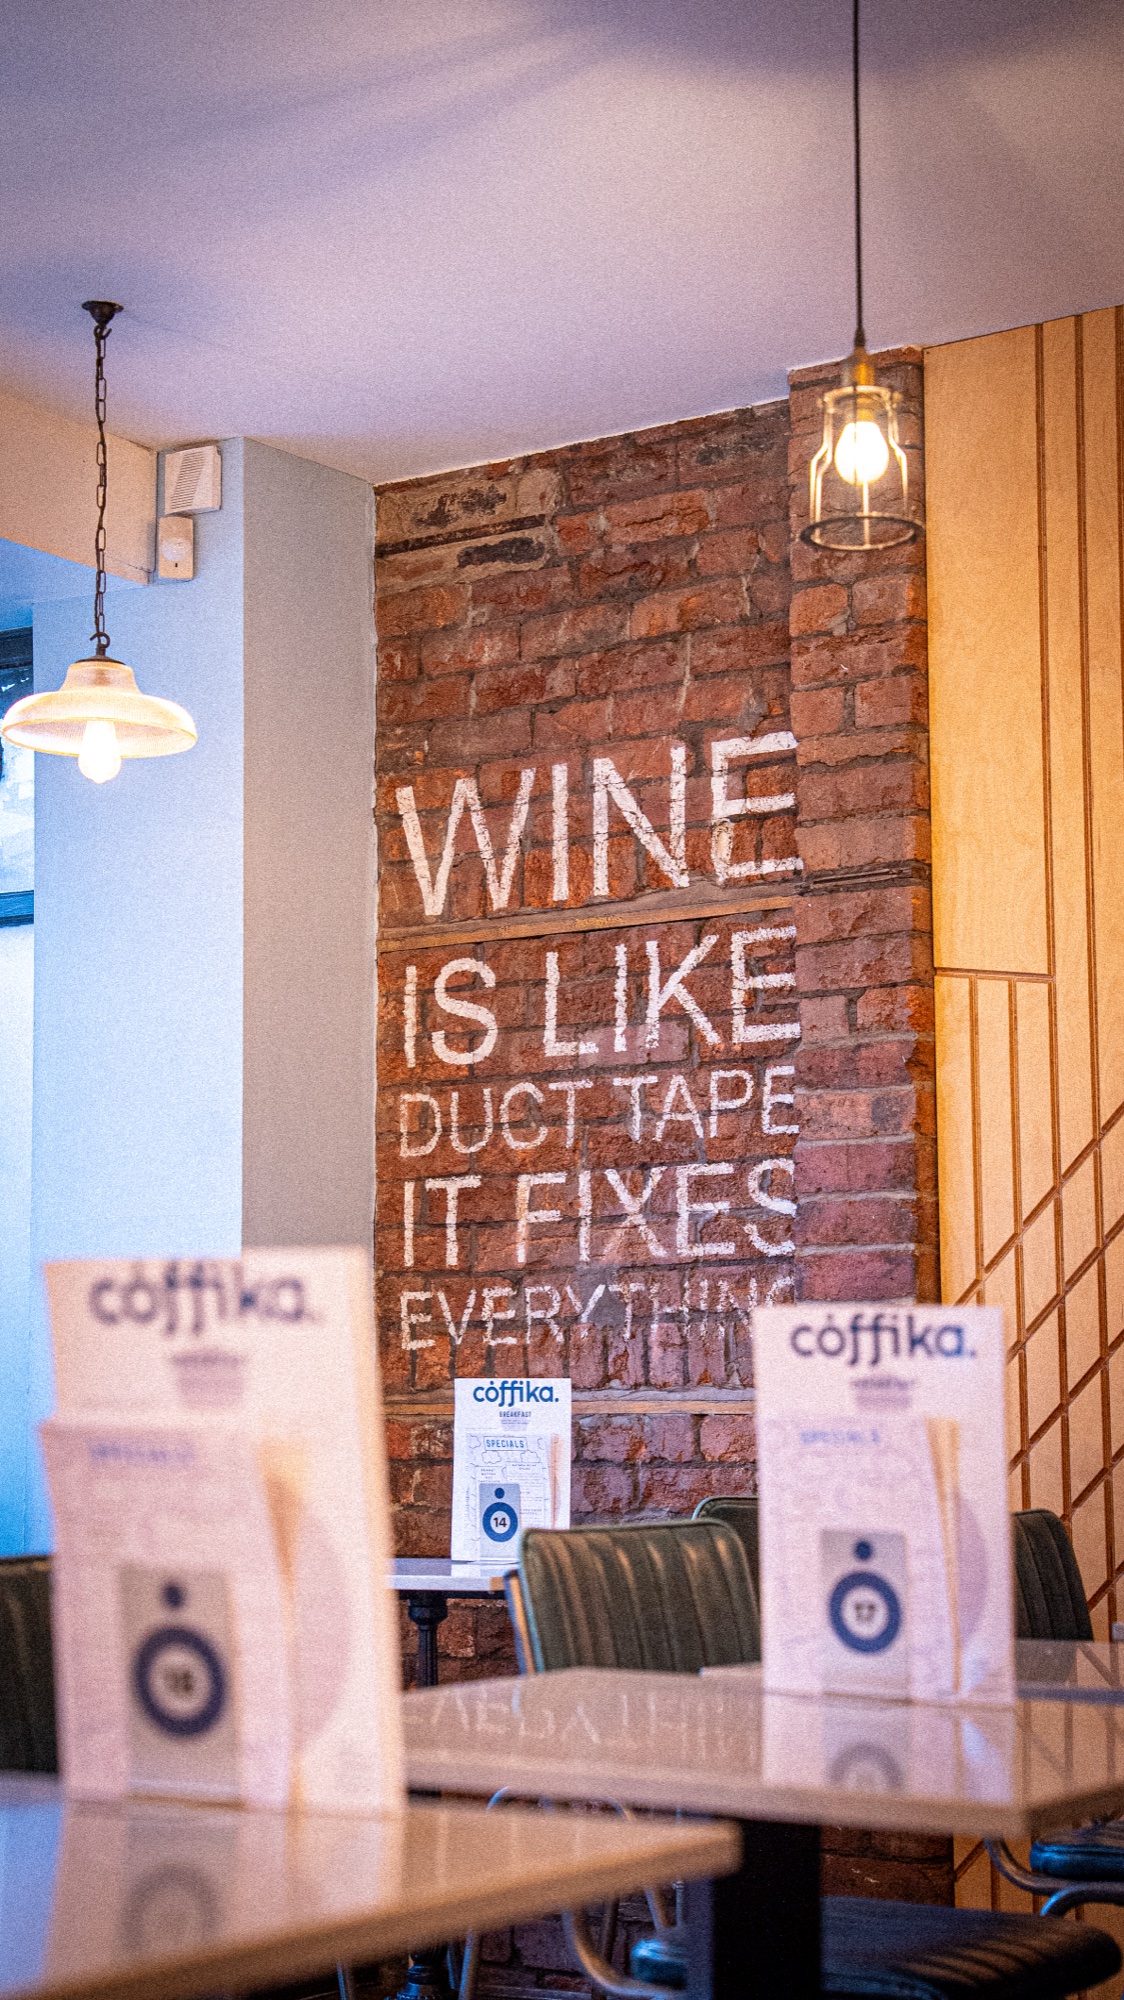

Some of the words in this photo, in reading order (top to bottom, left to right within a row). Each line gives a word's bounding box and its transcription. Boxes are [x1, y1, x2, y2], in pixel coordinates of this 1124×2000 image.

[395, 731, 804, 916] WINE
[403, 957, 497, 1069] IS
[543, 926, 801, 1057] LIKE
[400, 1079, 594, 1158] DUCT
[613, 1065, 799, 1143] TAPE
[403, 1175, 481, 1267] IT
[515, 1158, 797, 1263] FIXES
[485, 1438, 526, 1449] SPECIALS
[498, 1411, 532, 1419] BREAKFAST
[493, 1517, 508, 1528] 14
